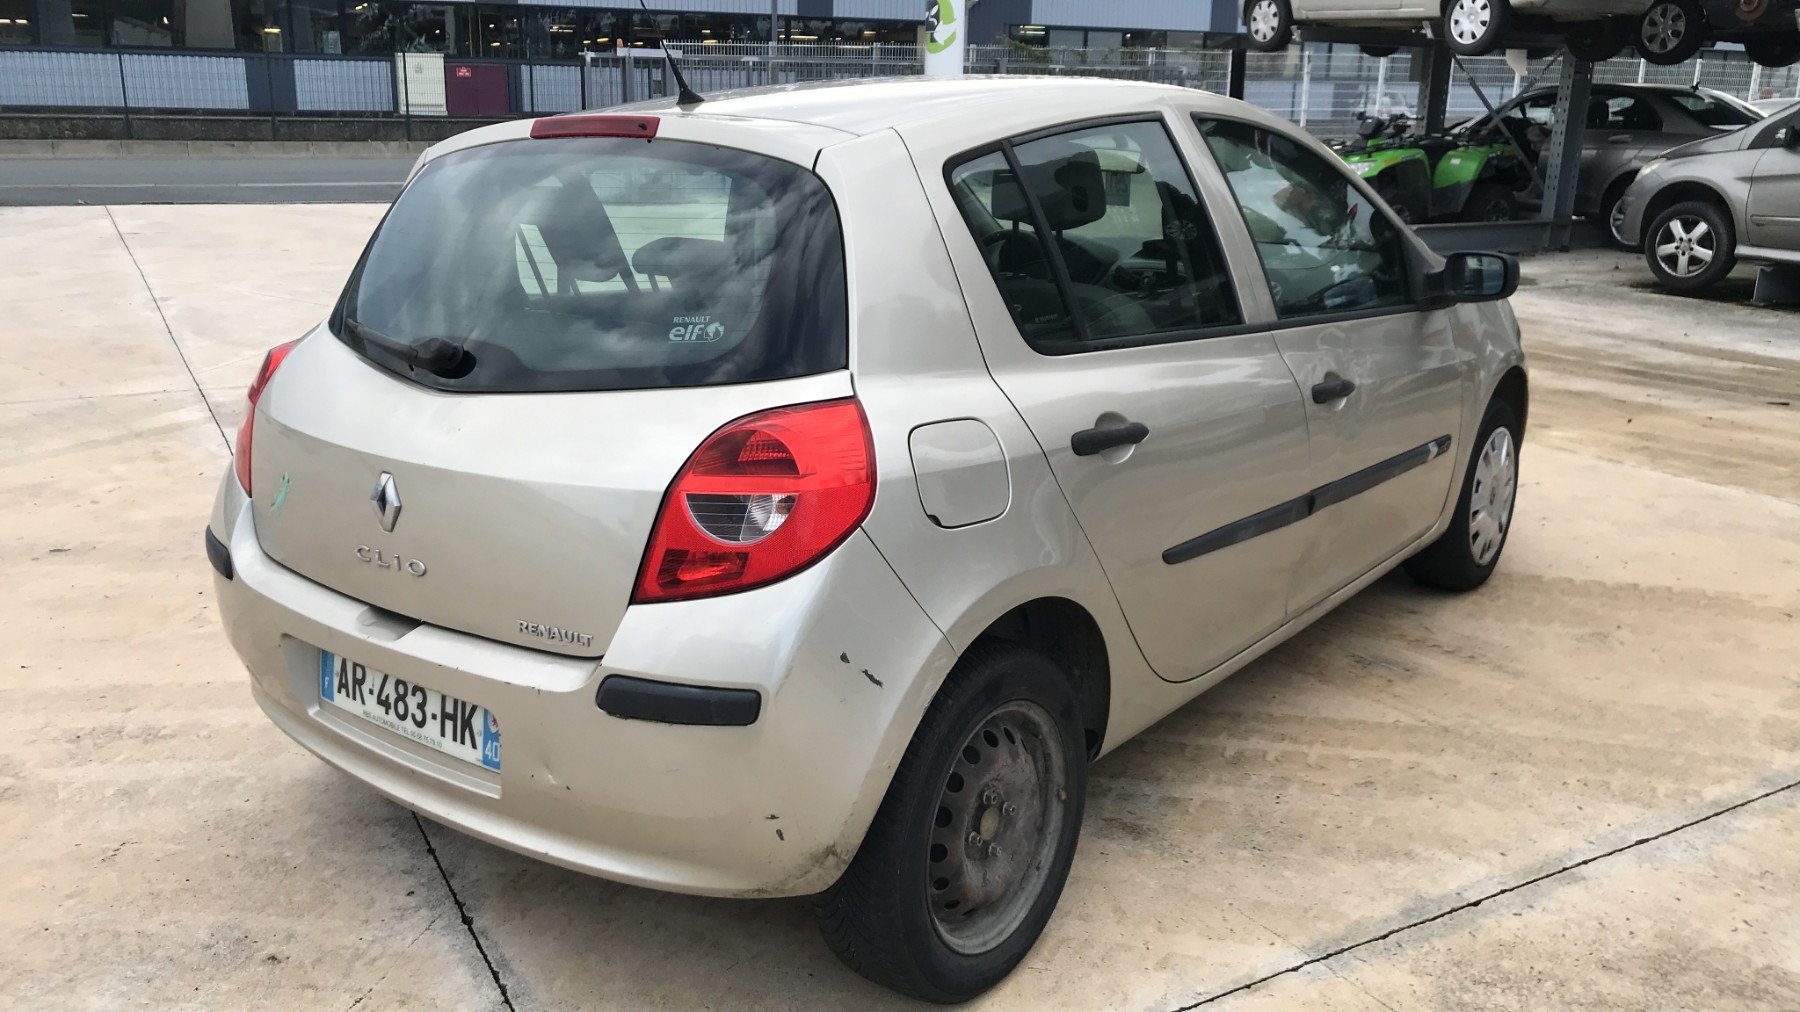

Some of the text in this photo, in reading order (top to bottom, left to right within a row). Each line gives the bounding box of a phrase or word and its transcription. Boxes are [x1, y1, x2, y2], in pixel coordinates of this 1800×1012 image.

[672, 315, 711, 324] RENAULT
[668, 324, 705, 341] elf
[355, 543, 428, 578] CLIO
[516, 618, 594, 648] RENAULT
[324, 676, 330, 689] F
[336, 657, 479, 750] AR-483-HK
[484, 740, 500, 762] 40
